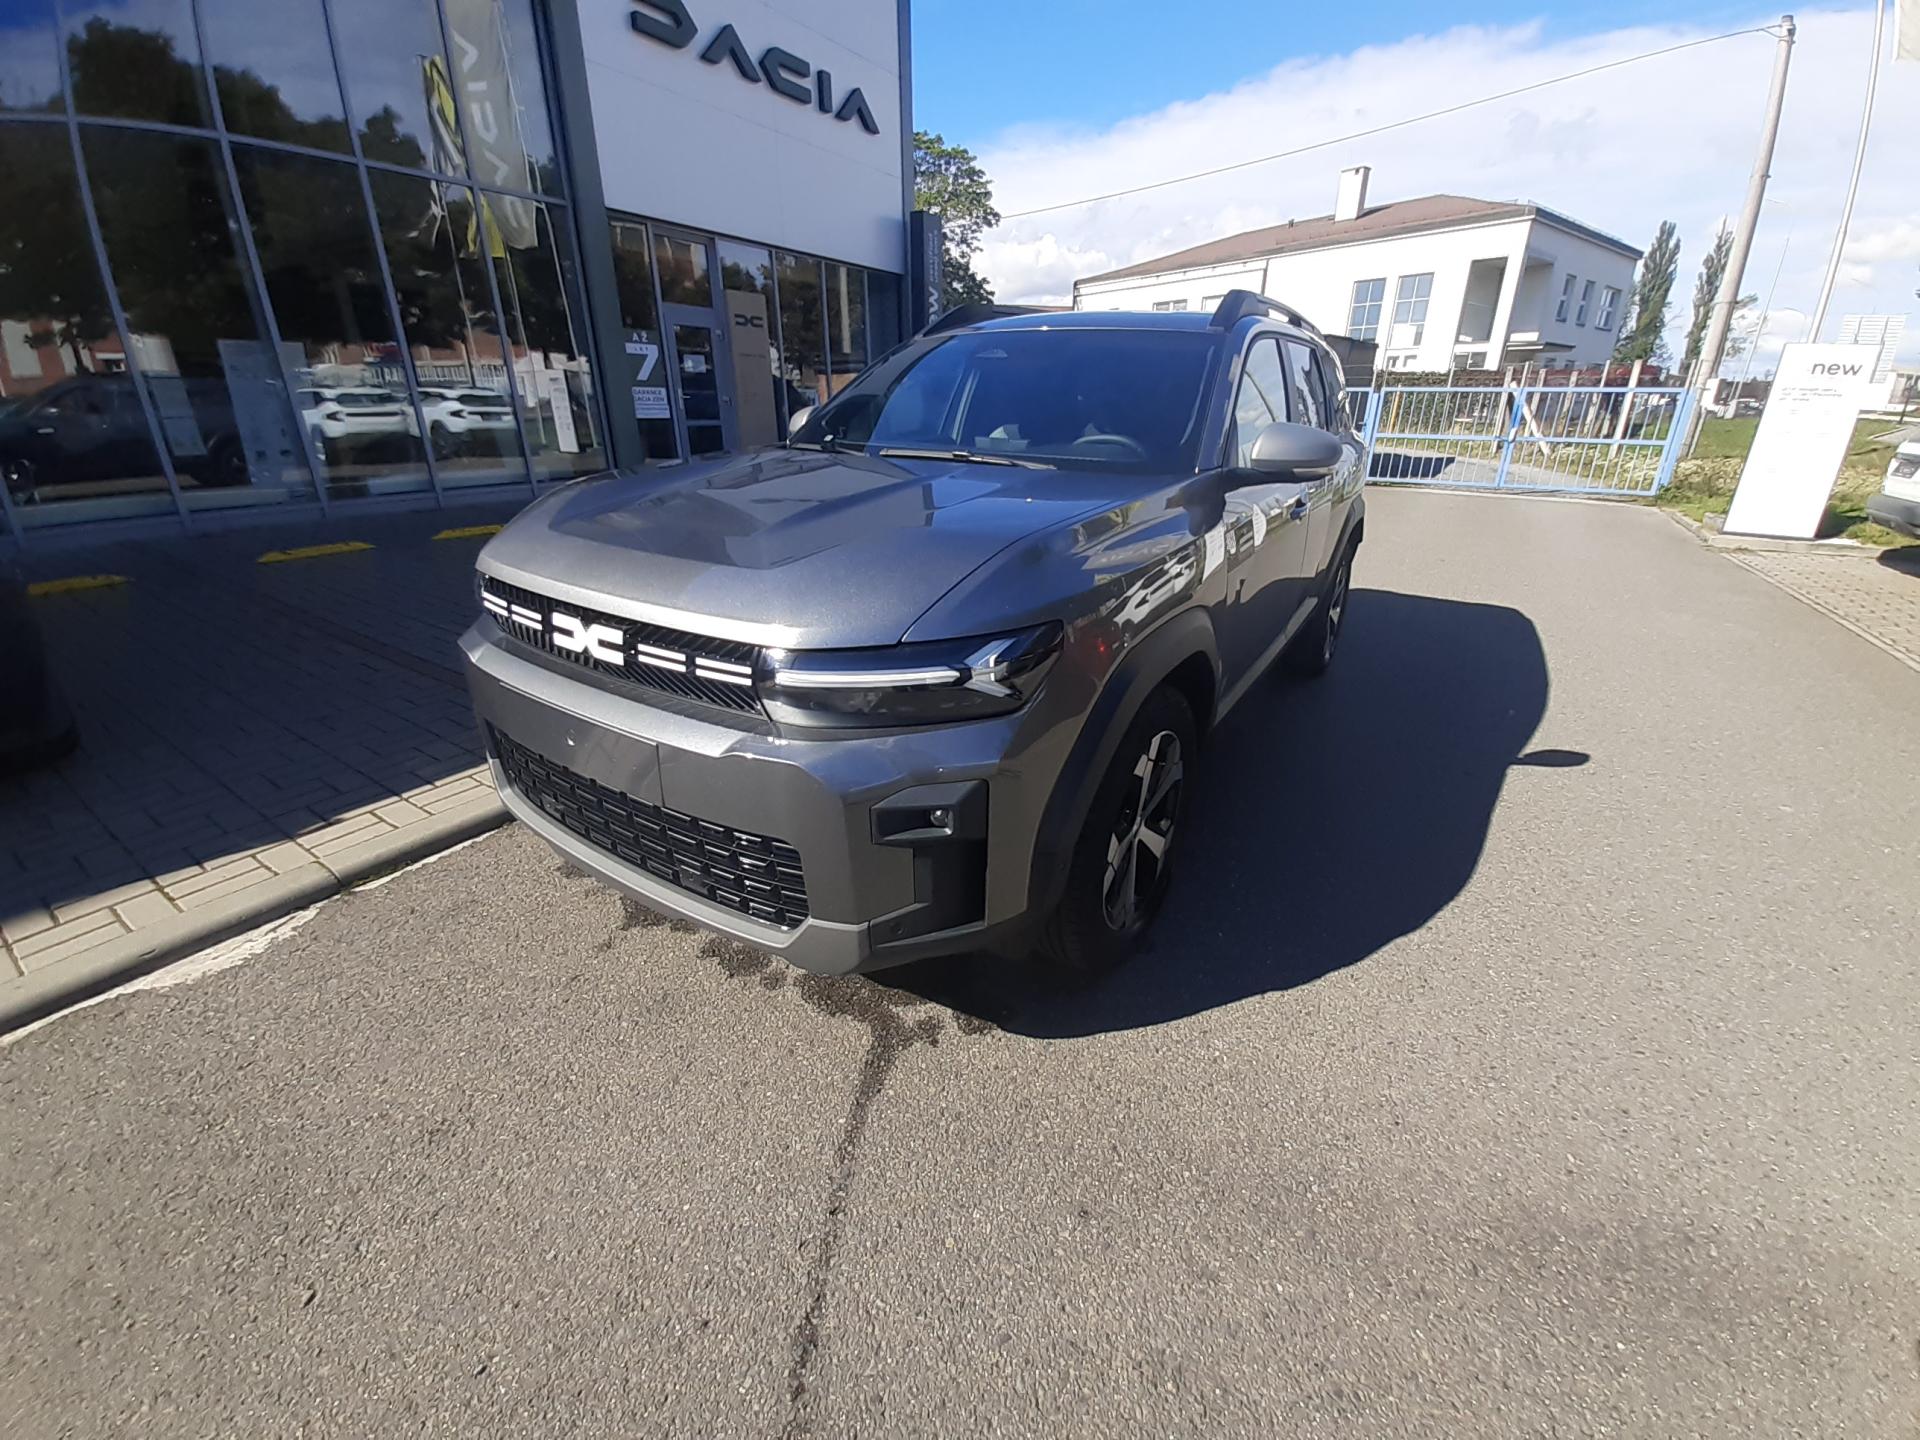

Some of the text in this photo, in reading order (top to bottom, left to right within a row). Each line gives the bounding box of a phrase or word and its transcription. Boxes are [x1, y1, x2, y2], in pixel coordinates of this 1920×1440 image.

[630, 0, 881, 135] DACIA
[624, 342, 659, 381] 7
[1811, 363, 1863, 376] new
